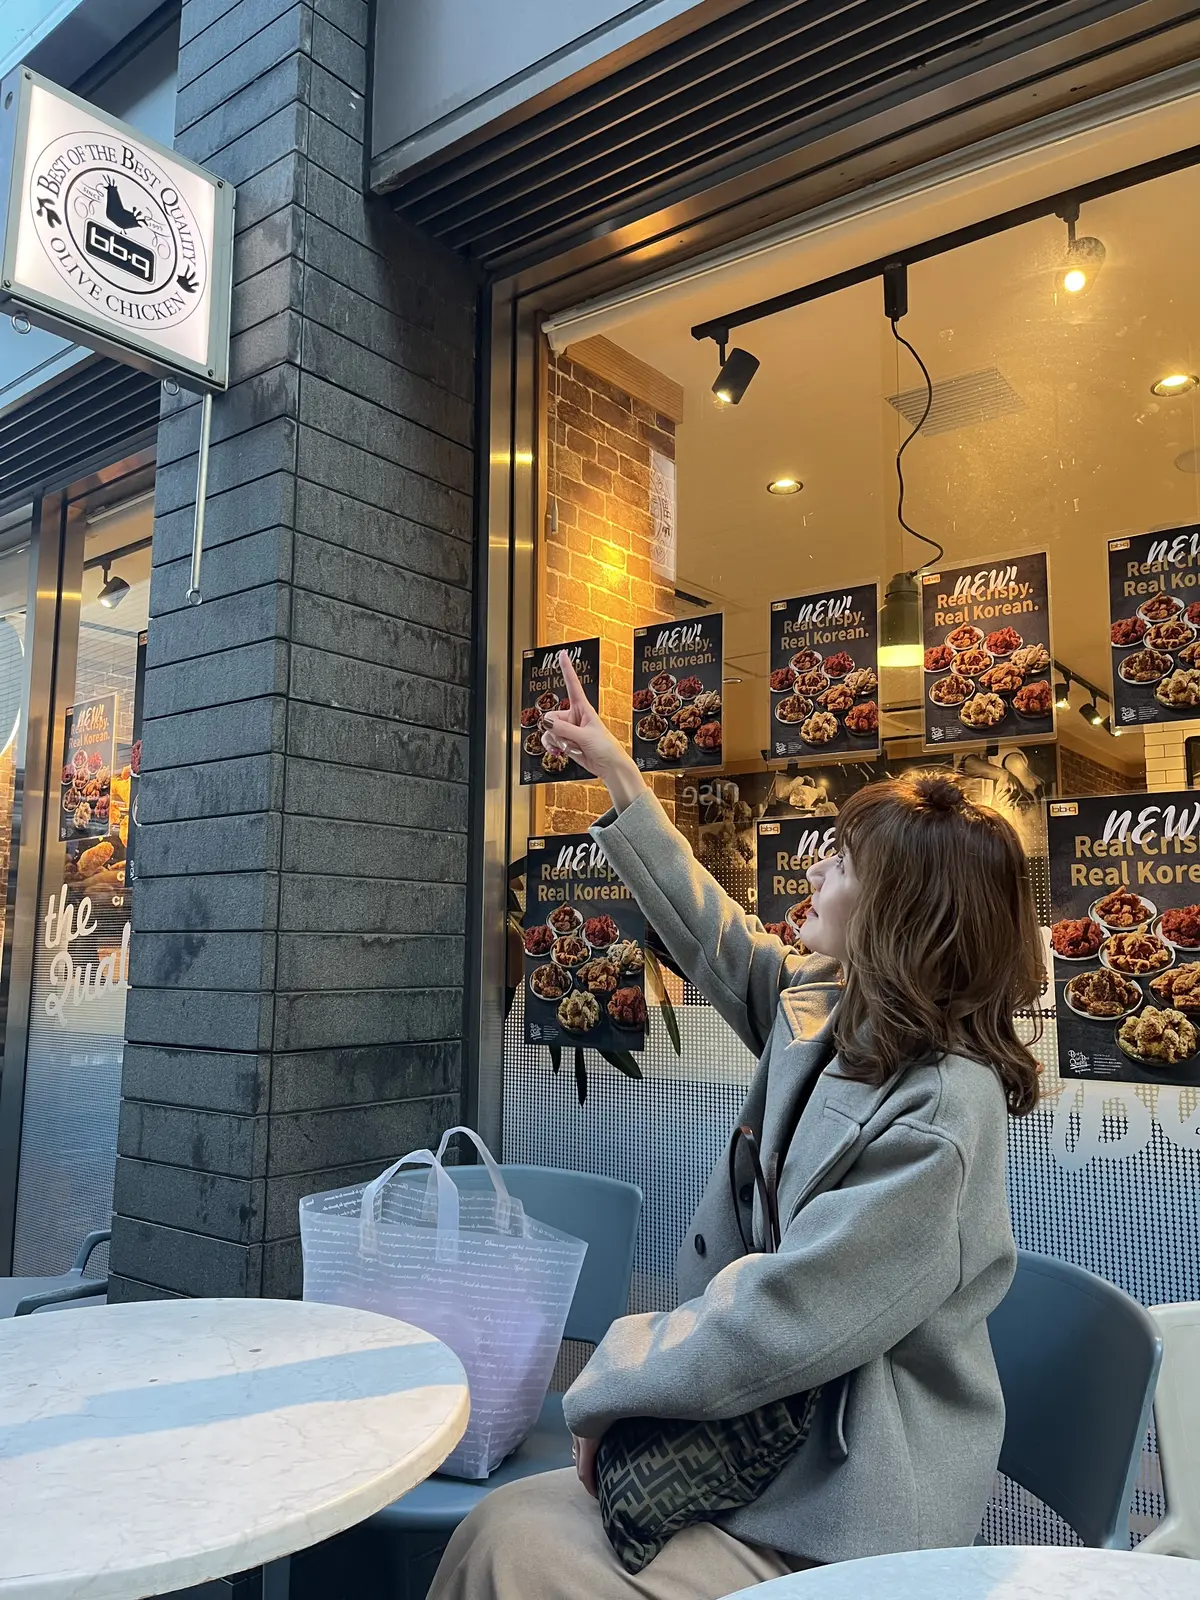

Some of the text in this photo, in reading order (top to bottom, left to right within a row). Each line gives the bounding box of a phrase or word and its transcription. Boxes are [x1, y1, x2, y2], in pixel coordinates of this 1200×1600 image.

[37, 144, 197, 266] BEST OF THE BEST QUALITY
[50, 237, 187, 321] OLIVE CHICKEN
[1127, 555, 1169, 577] Real
[954, 565, 1018, 598] NEW!
[1124, 574, 1166, 597] Real
[937, 582, 1033, 609] Real Crispy.
[783, 610, 865, 634] Real Crispy.
[797, 595, 853, 624] NEW!
[934, 599, 1039, 627] Real Korean.
[644, 637, 713, 658] Real Crispy.
[656, 623, 702, 649] NEW!
[781, 626, 869, 650] Real Korean.
[642, 653, 716, 673] Real Korean.
[529, 677, 551, 692] Real
[1074, 831, 1200, 858] Real Cris
[541, 862, 573, 880] Real
[1070, 861, 1130, 886] Real
[538, 883, 570, 902] Real
[45, 884, 97, 948] the
